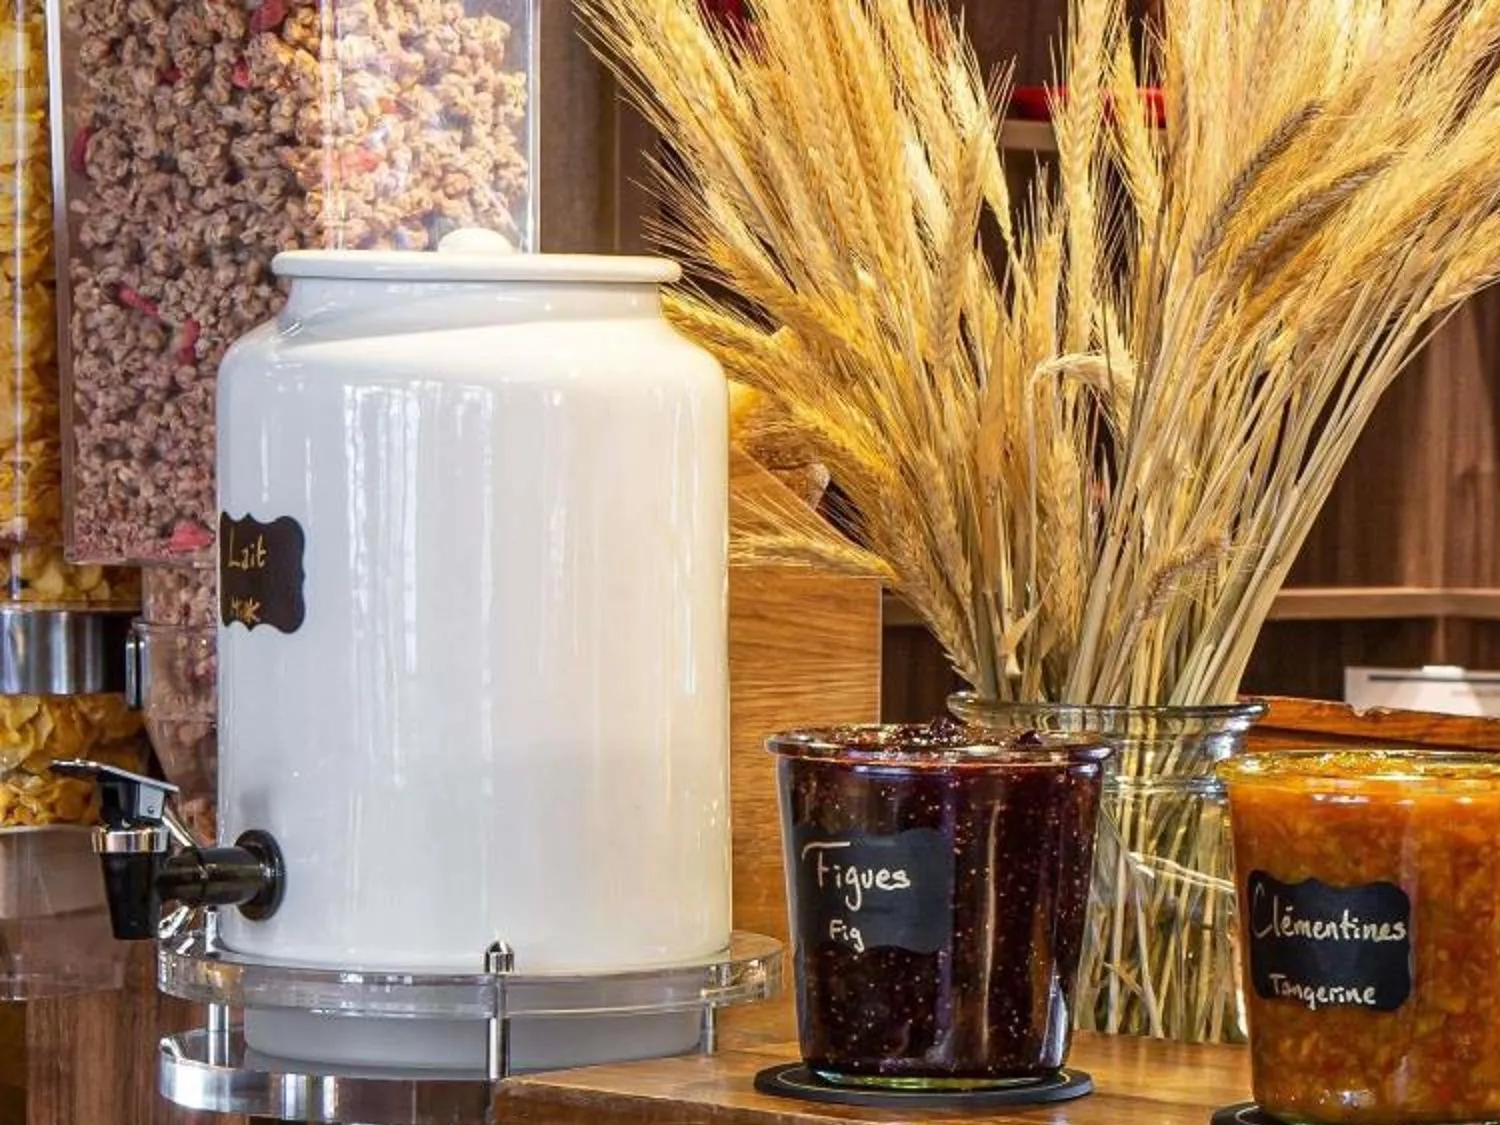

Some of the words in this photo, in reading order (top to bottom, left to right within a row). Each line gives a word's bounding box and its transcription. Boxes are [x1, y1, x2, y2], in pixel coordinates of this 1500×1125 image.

[227, 526, 268, 571] Lait
[802, 841, 911, 912] Figues
[829, 919, 865, 953] Fig
[1268, 973, 1377, 1010] Tangerine
